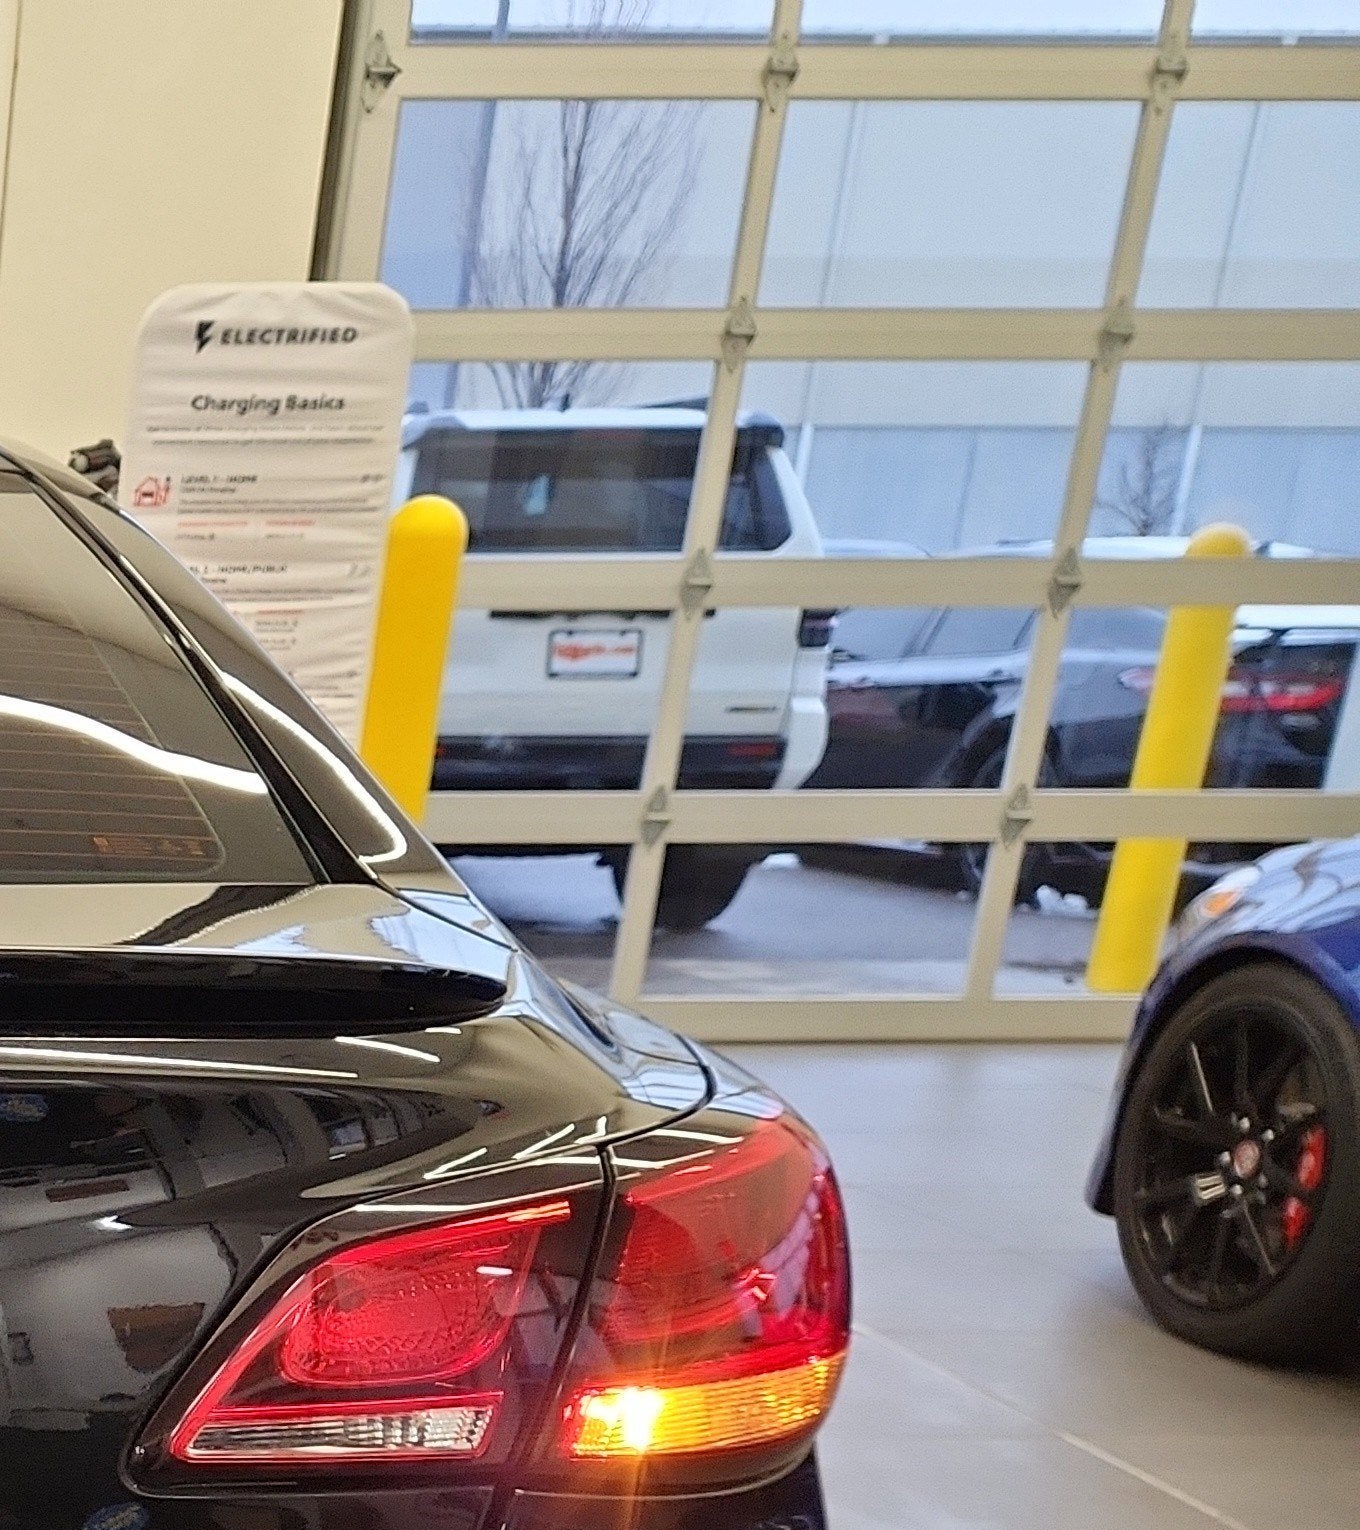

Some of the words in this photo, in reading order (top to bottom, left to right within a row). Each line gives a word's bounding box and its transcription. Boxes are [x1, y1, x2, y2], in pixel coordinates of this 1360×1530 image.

[220, 327, 358, 345] ELECTRIFIED
[190, 394, 279, 416] Charging
[284, 395, 346, 410] Basics
